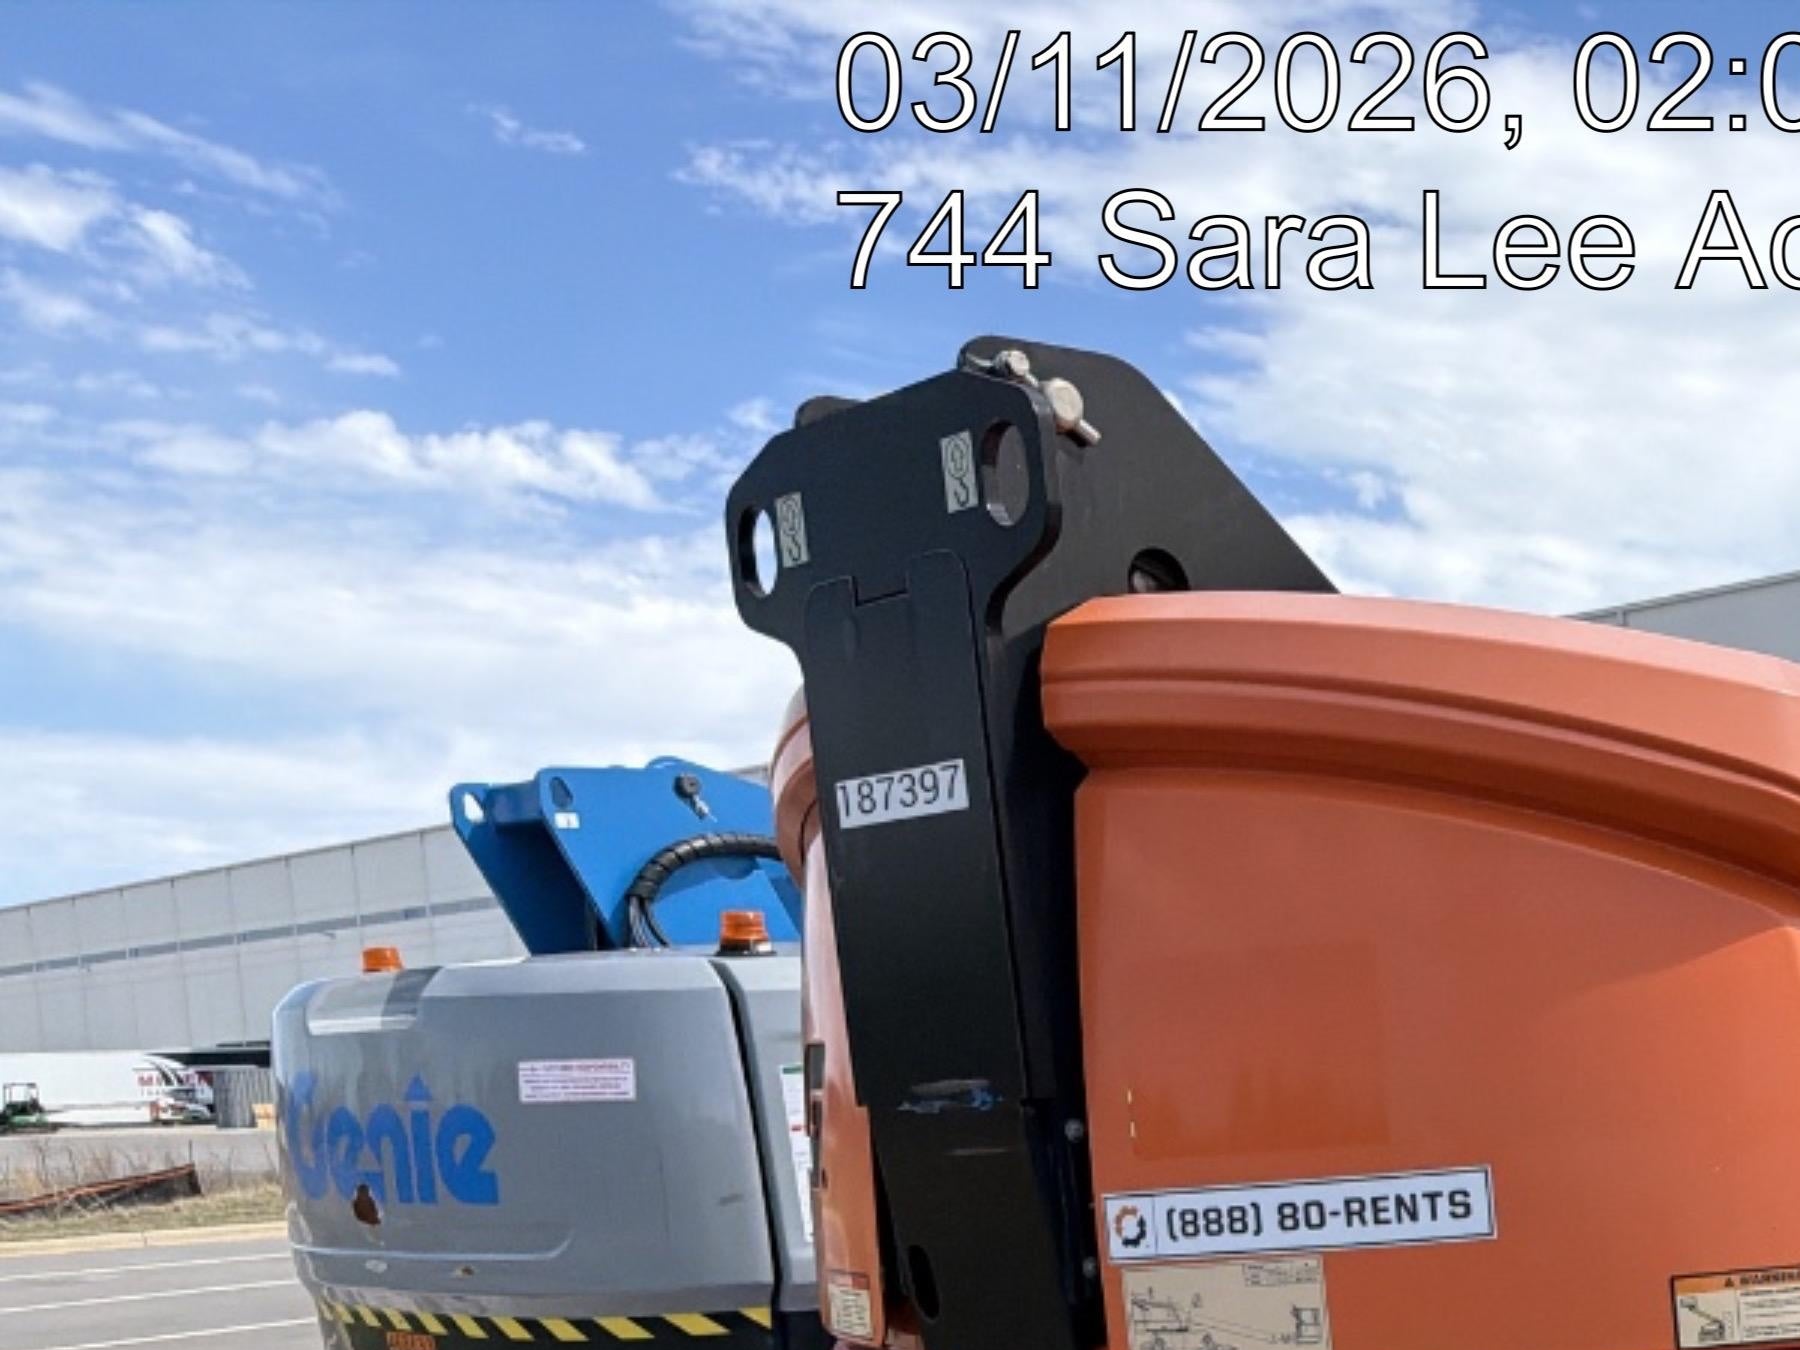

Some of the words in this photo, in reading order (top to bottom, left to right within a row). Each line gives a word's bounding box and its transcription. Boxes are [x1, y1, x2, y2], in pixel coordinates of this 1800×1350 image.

[839, 764, 961, 817] 187397
[287, 1070, 500, 1206] Genie
[1166, 1201, 1263, 1242] (888)
[1276, 1188, 1472, 1232] 80-RENTS
